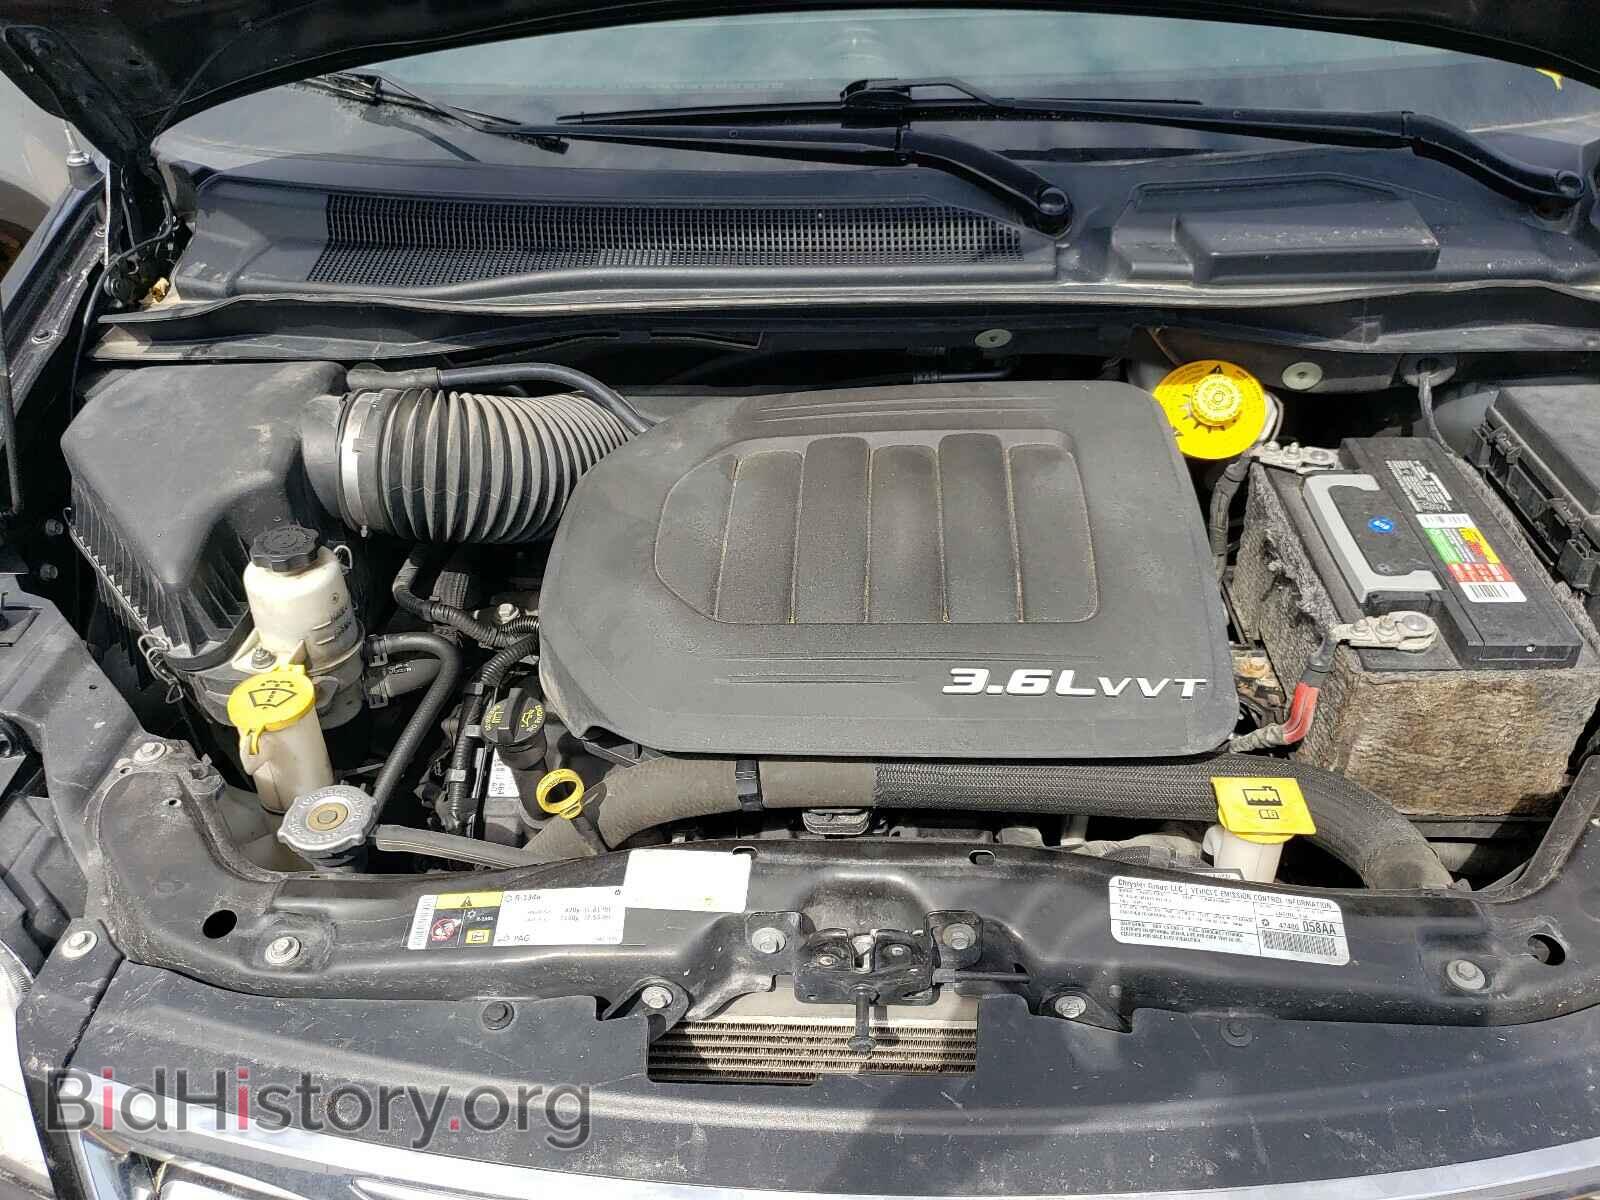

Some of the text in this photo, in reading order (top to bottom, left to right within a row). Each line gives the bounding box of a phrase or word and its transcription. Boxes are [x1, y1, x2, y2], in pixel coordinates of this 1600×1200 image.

[942, 668, 1207, 698] 3.6L VVT
[1118, 879, 1146, 890] Chrysler
[1170, 885, 1183, 893] LLC
[1220, 890, 1252, 900] EMISSION
[1254, 894, 1282, 904] CONTROL
[1303, 921, 1337, 935] 058AA
